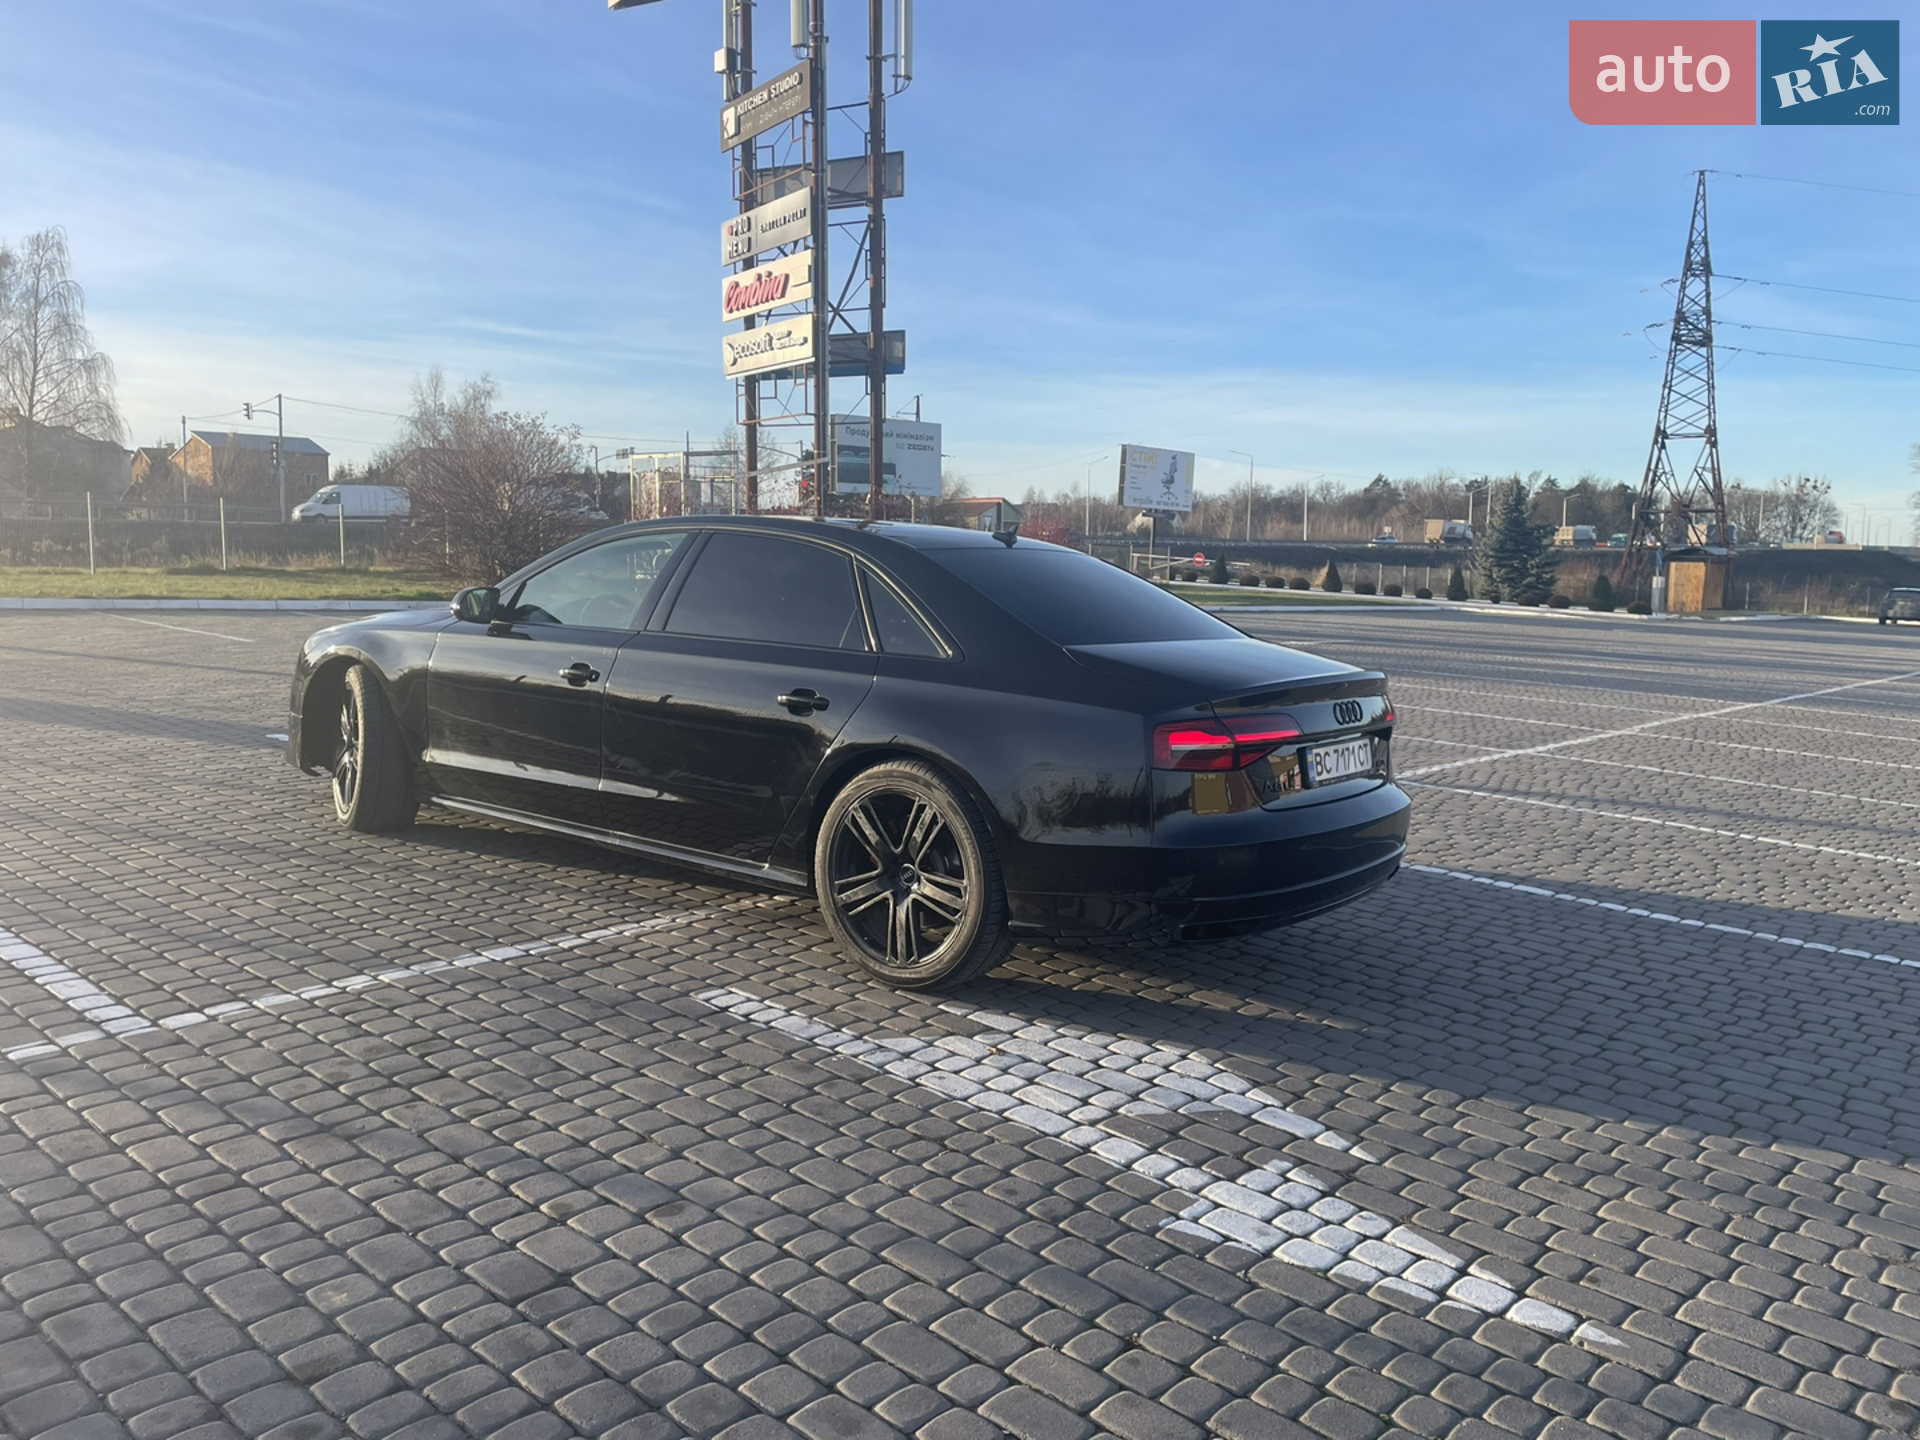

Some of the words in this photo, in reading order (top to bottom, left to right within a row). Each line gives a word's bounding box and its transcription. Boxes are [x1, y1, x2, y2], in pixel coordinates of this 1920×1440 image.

[737, 89, 768, 116] KITCHEN
[770, 71, 800, 98] STUDIO
[725, 270, 788, 314] Combina
[1315, 751, 1332, 777] BC
[1333, 745, 1357, 772] 7171
[1357, 743, 1369, 767] CT
